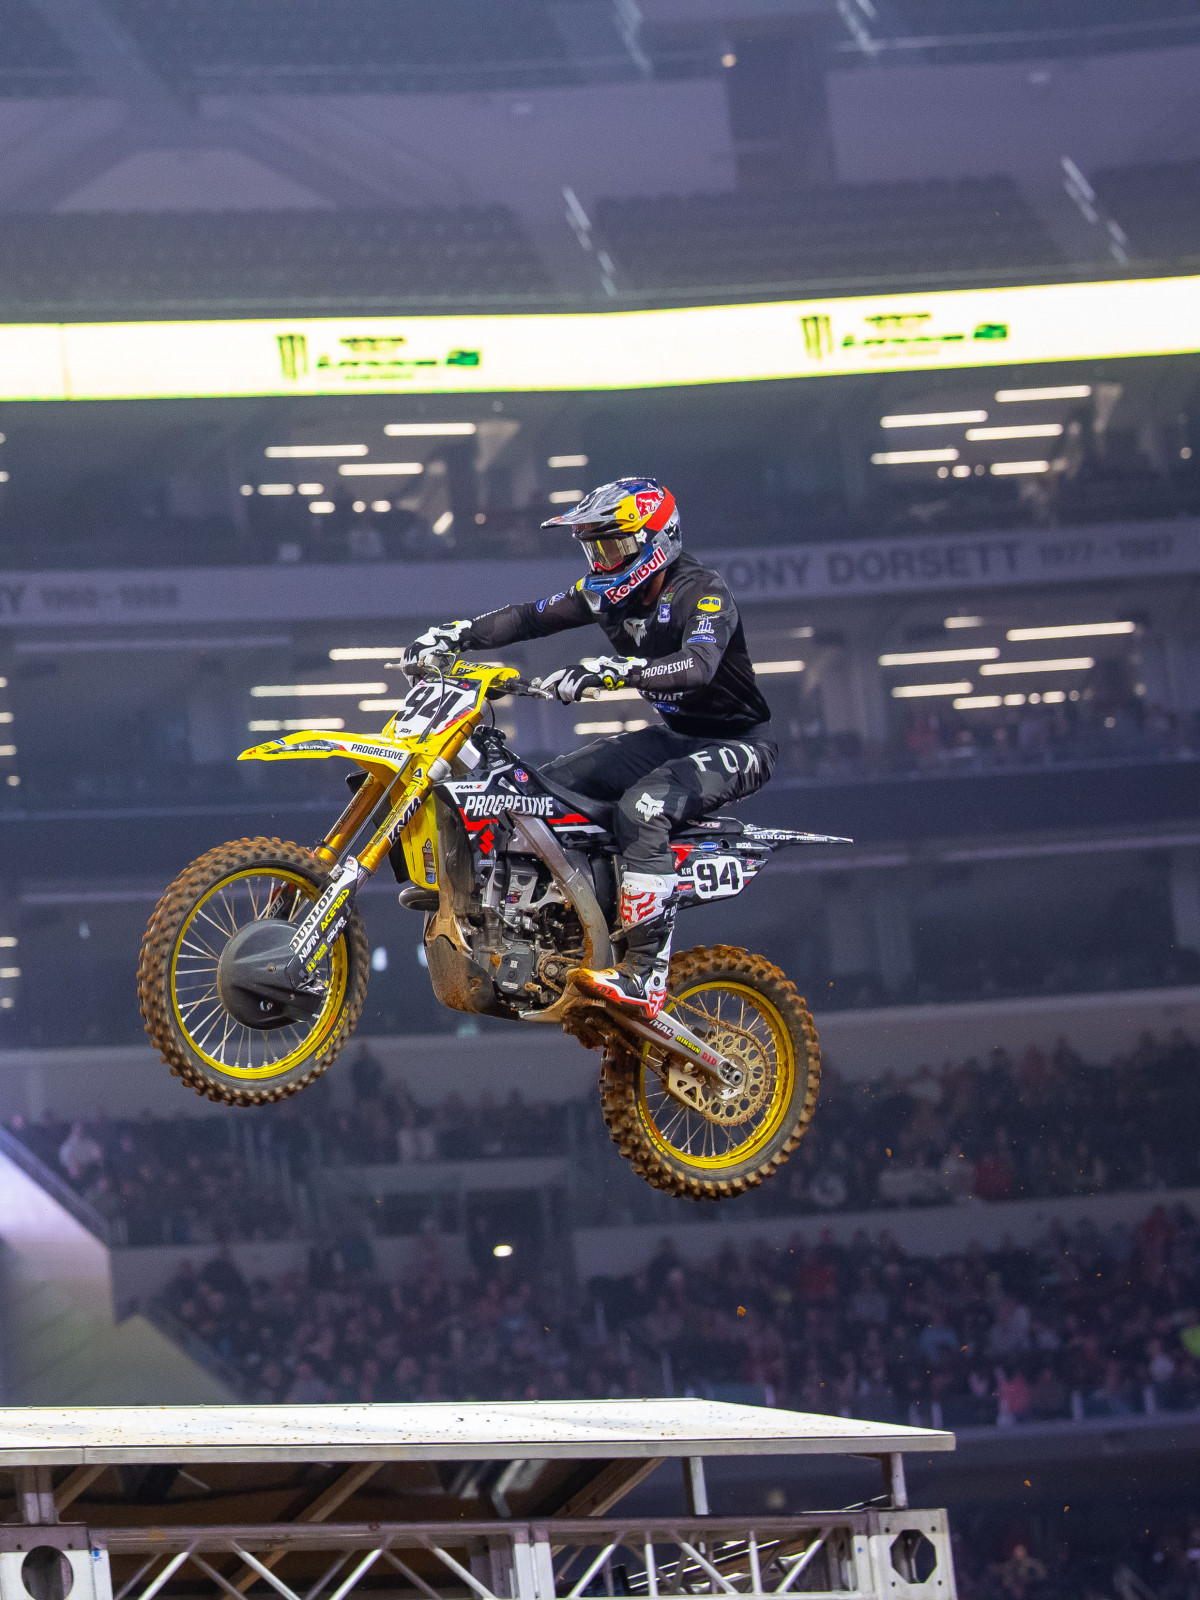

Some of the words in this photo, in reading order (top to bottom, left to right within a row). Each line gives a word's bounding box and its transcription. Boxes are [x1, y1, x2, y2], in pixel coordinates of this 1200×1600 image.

[604, 571, 641, 604] Red
[636, 546, 667, 581] Bull
[827, 542, 1021, 586] DORSETT
[395, 686, 464, 730] 94
[351, 743, 405, 761] PROGRESSIVE
[688, 744, 760, 774] FOX
[463, 794, 554, 817] PROGRESSIVE
[681, 867, 692, 876] KR
[696, 861, 740, 893] 94
[289, 886, 334, 952] DUNLOP
